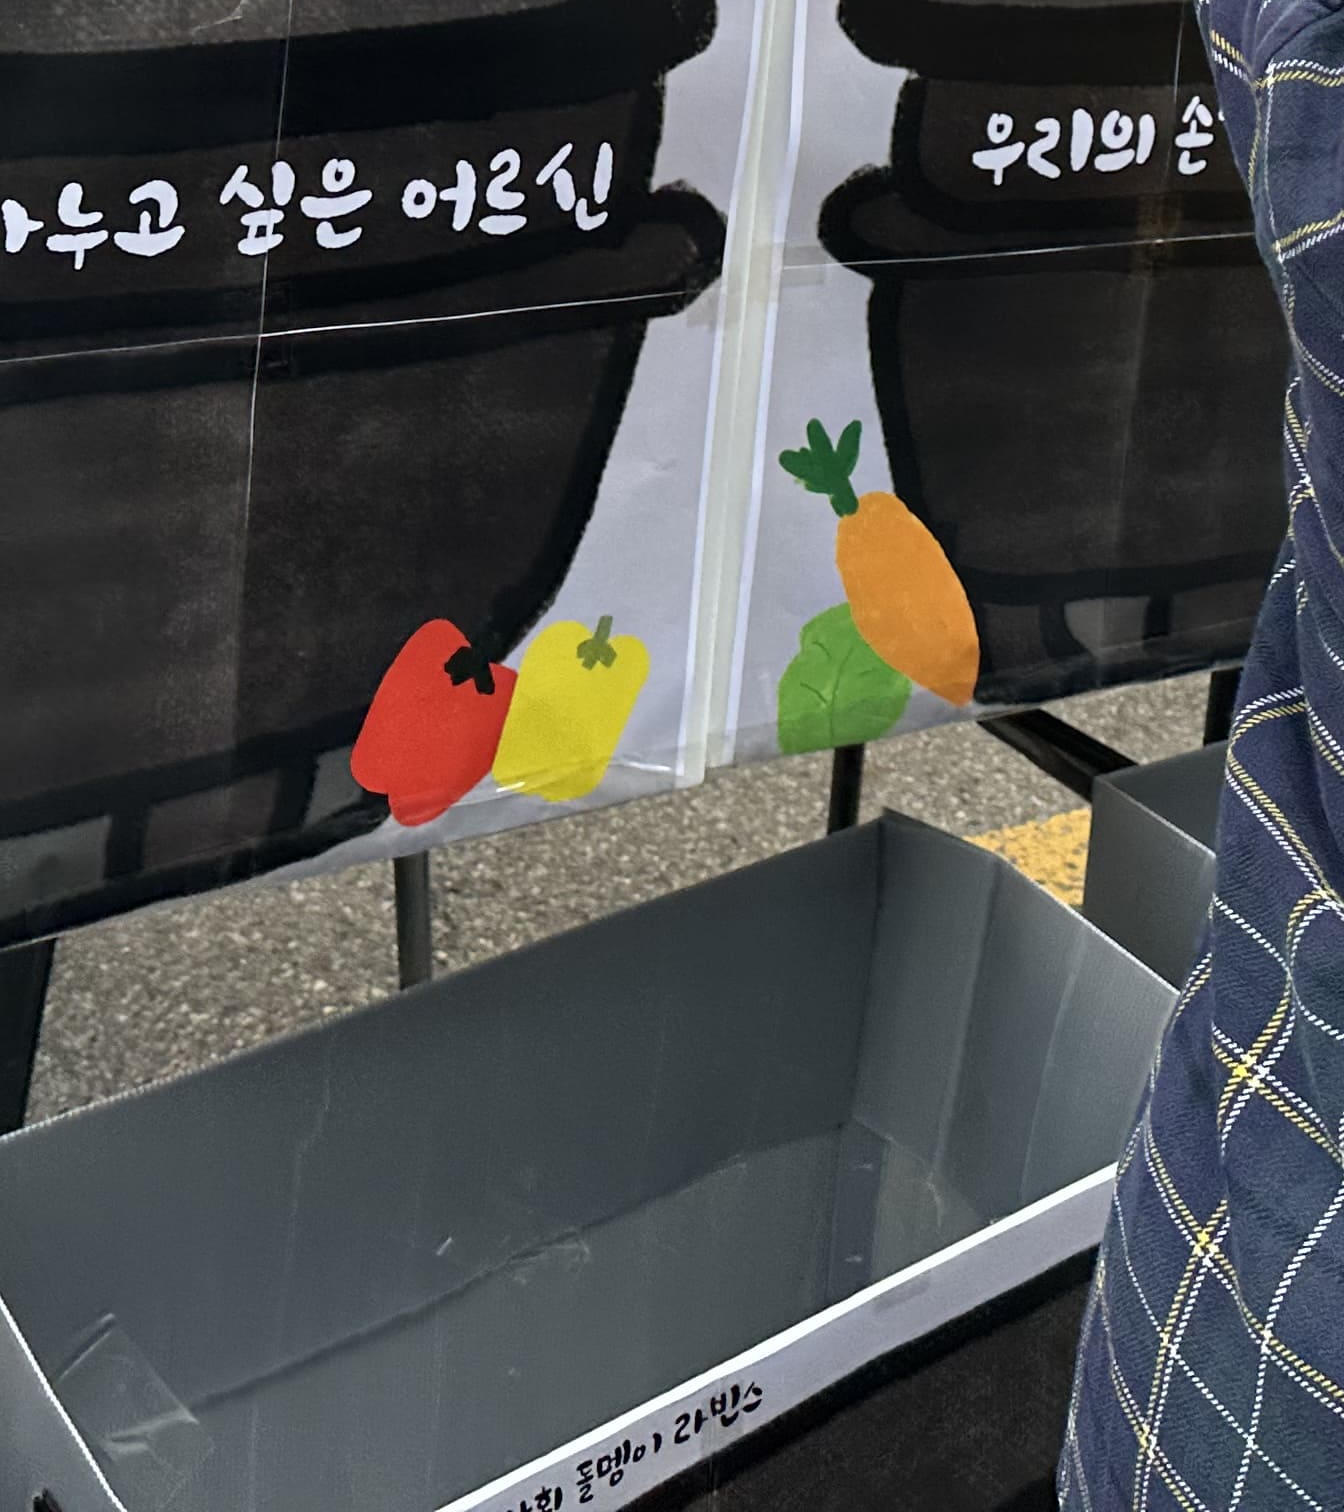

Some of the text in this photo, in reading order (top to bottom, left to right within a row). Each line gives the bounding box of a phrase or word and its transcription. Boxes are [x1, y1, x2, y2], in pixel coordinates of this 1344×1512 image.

[972, 95, 1225, 186] 우리의 손
[219, 158, 373, 256] 싶은
[401, 142, 613, 235] 어르신
[576, 1432, 662, 1504] 돌멩이
[673, 1382, 764, 1444] 라빈스
